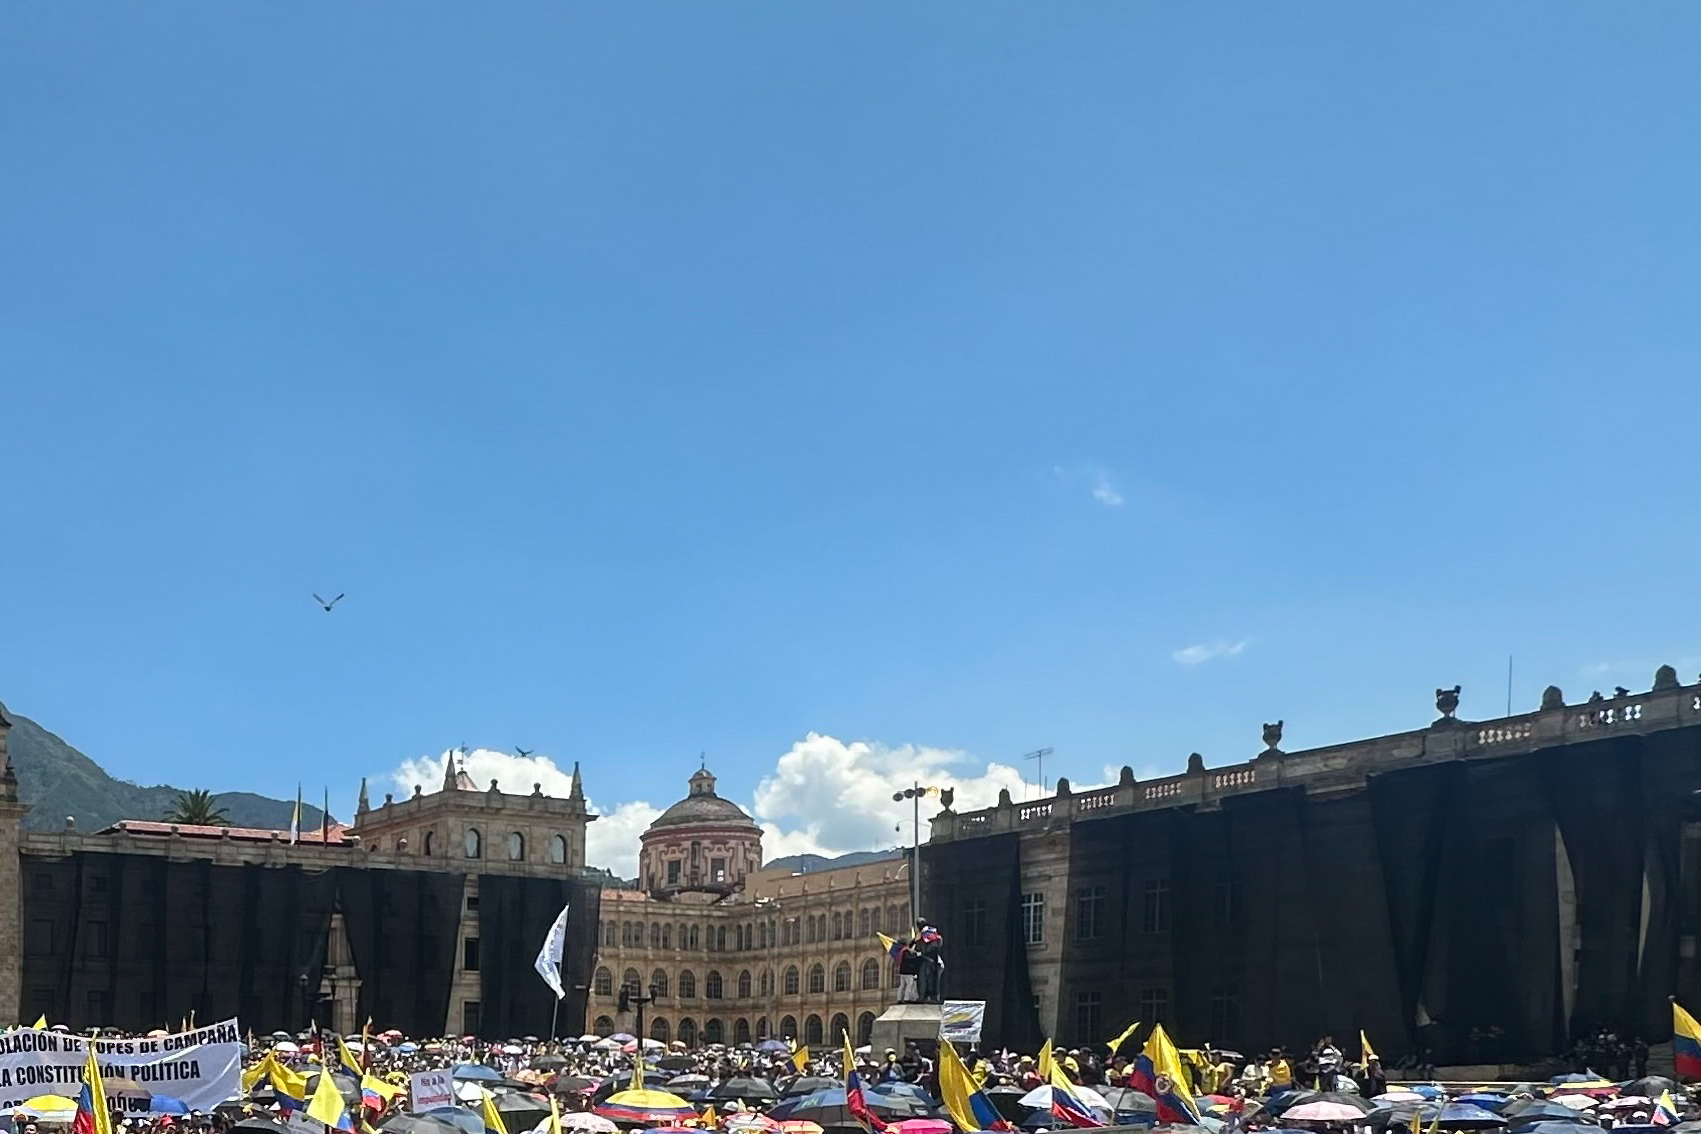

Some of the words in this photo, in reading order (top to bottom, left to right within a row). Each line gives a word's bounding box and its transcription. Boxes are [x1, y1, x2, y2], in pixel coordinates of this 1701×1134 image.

[63, 1037, 82, 1053] DE
[139, 1040, 159, 1054] DE
[163, 1024, 238, 1052] CAMPAÑA
[16, 1063, 125, 1086] CONSTITUIÓN
[130, 1059, 201, 1082] POLÍTICA
